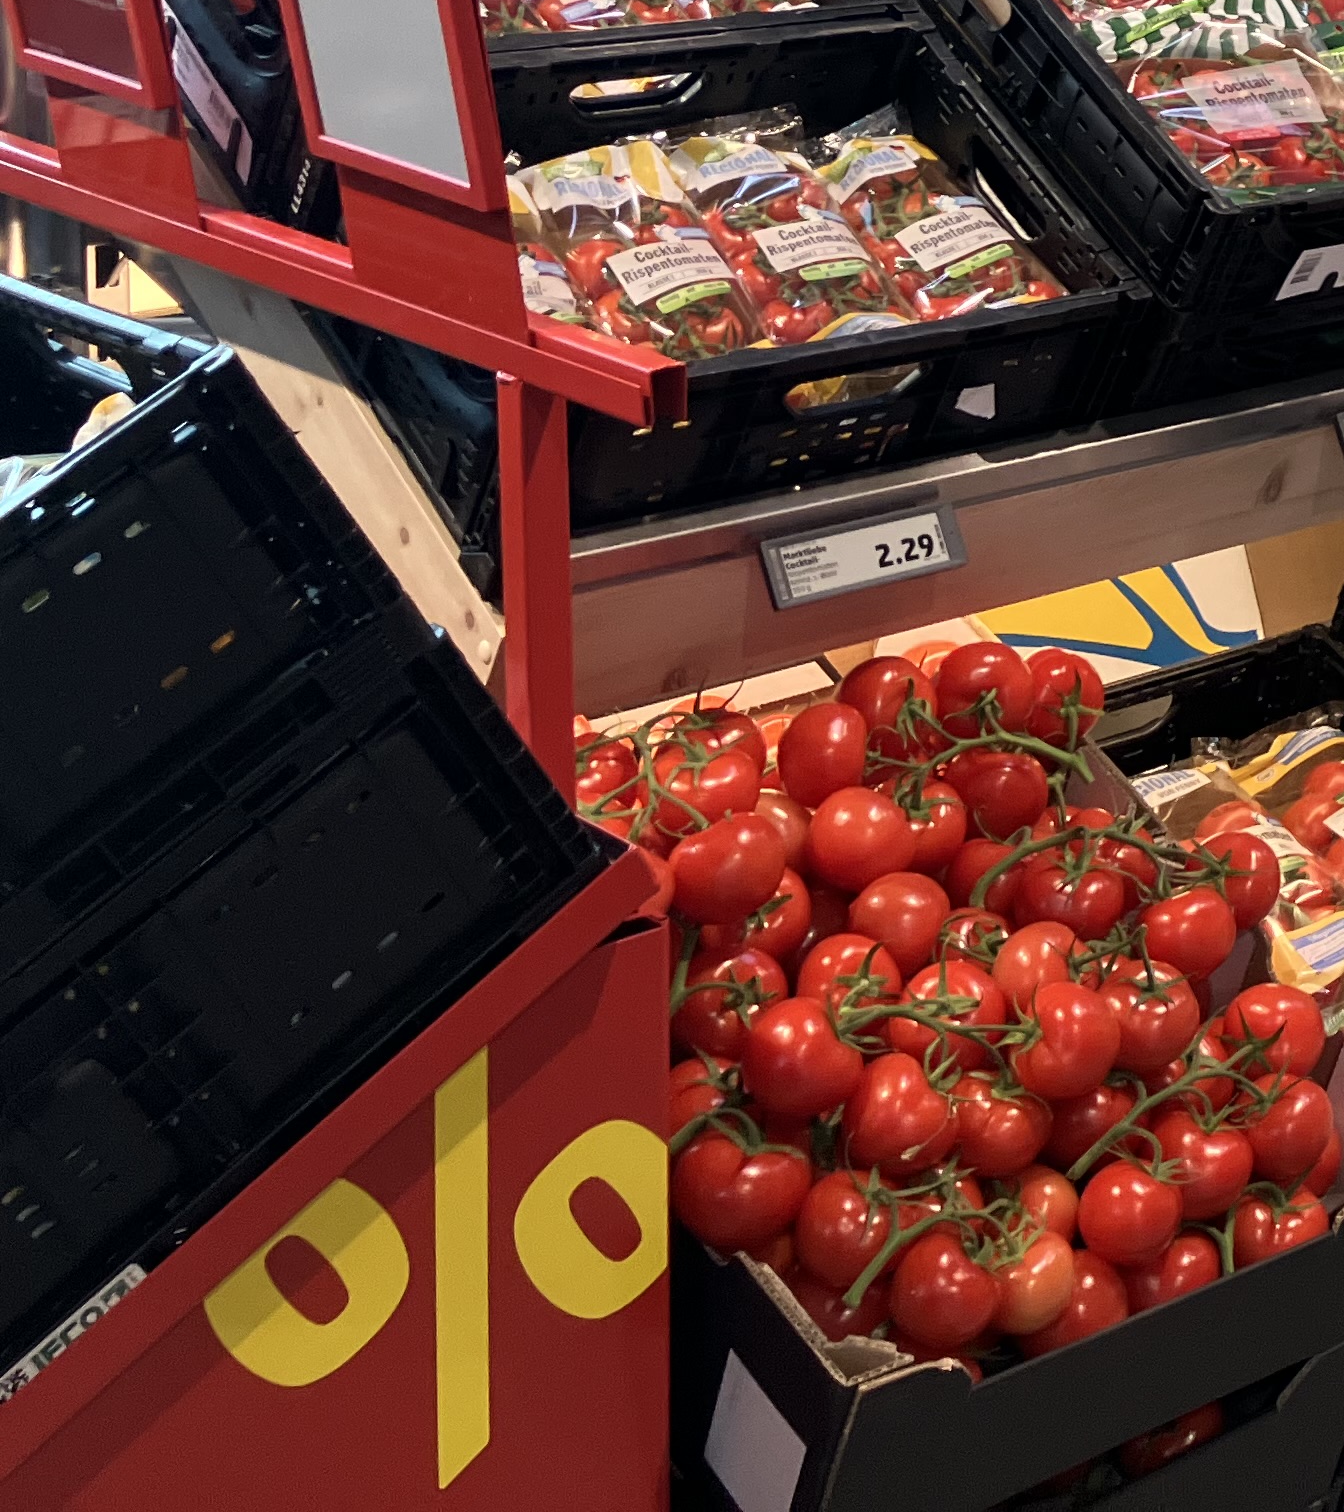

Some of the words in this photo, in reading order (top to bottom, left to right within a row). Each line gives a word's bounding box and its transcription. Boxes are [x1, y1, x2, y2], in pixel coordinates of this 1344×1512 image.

[1213, 72, 1275, 94] Cocktail-
[777, 223, 835, 241] Cocktail-
[917, 212, 975, 234] Cocktail-
[766, 233, 859, 257] Rispentomaten
[909, 218, 1001, 254] Rispentomaten
[633, 244, 695, 265] Cocktail-
[620, 251, 723, 284] Rispentomaten
[874, 533, 935, 570] 2.29
[203, 1044, 668, 1490] %
